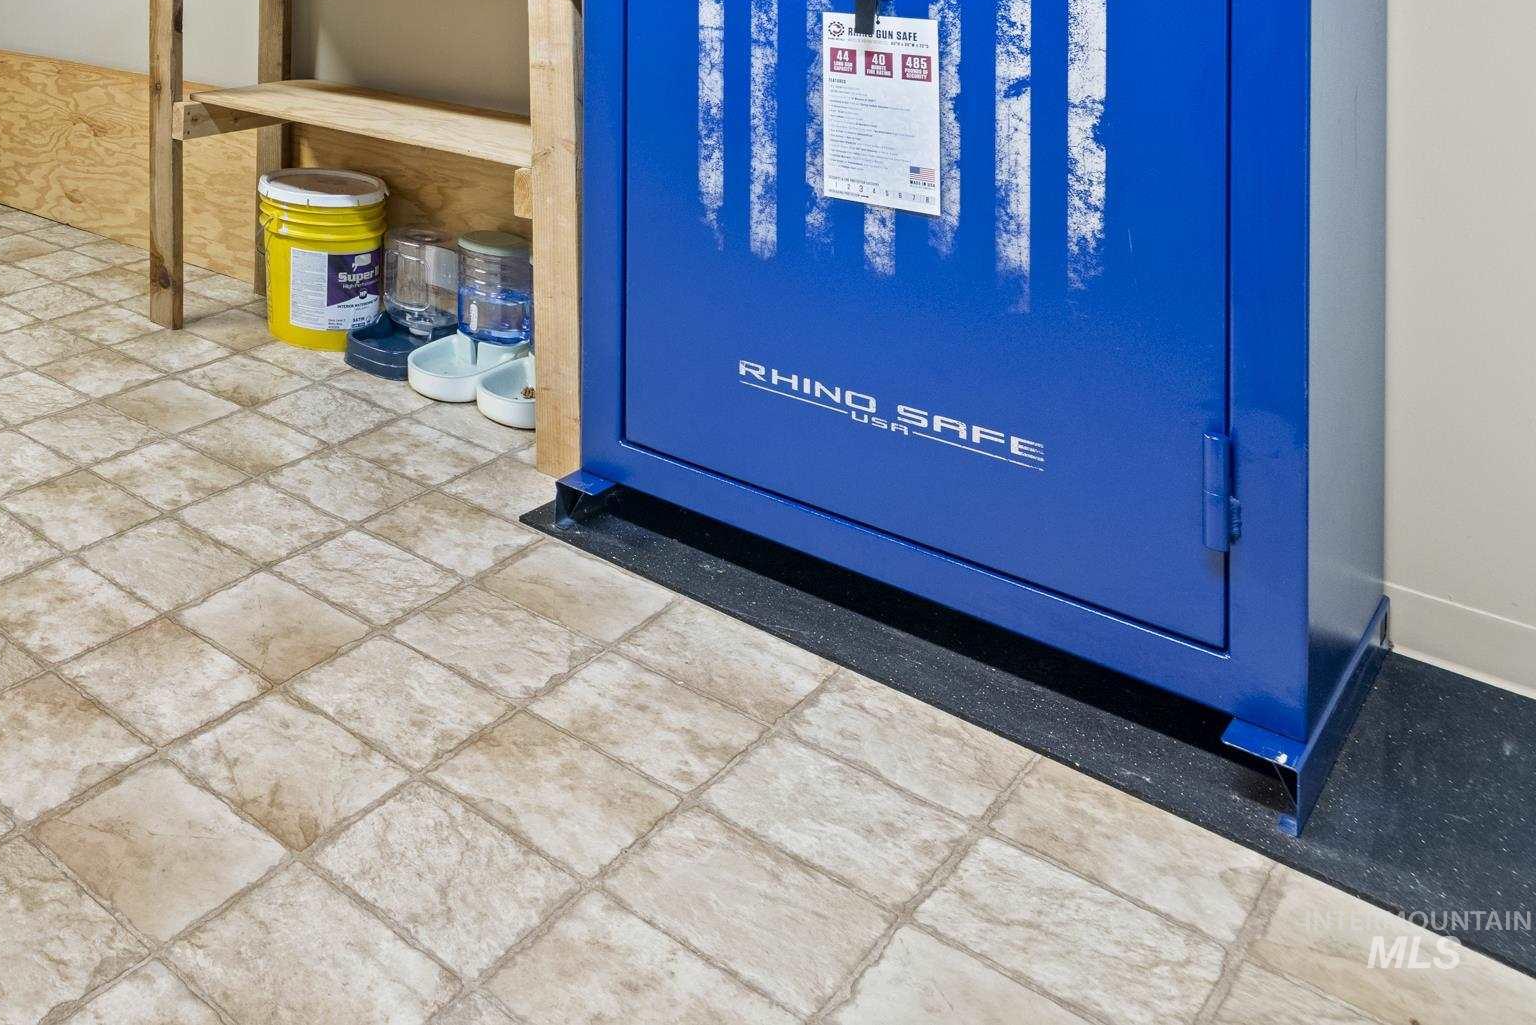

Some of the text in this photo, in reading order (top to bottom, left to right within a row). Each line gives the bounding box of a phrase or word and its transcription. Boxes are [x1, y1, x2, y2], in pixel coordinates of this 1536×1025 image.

[876, 30, 893, 39] GUN
[897, 31, 918, 42] SAFE
[837, 50, 849, 62] 44
[872, 54, 886, 66] 40
[906, 56, 928, 69] 485
[739, 359, 1045, 462] RHINO SAFE
[851, 410, 909, 436] USA
